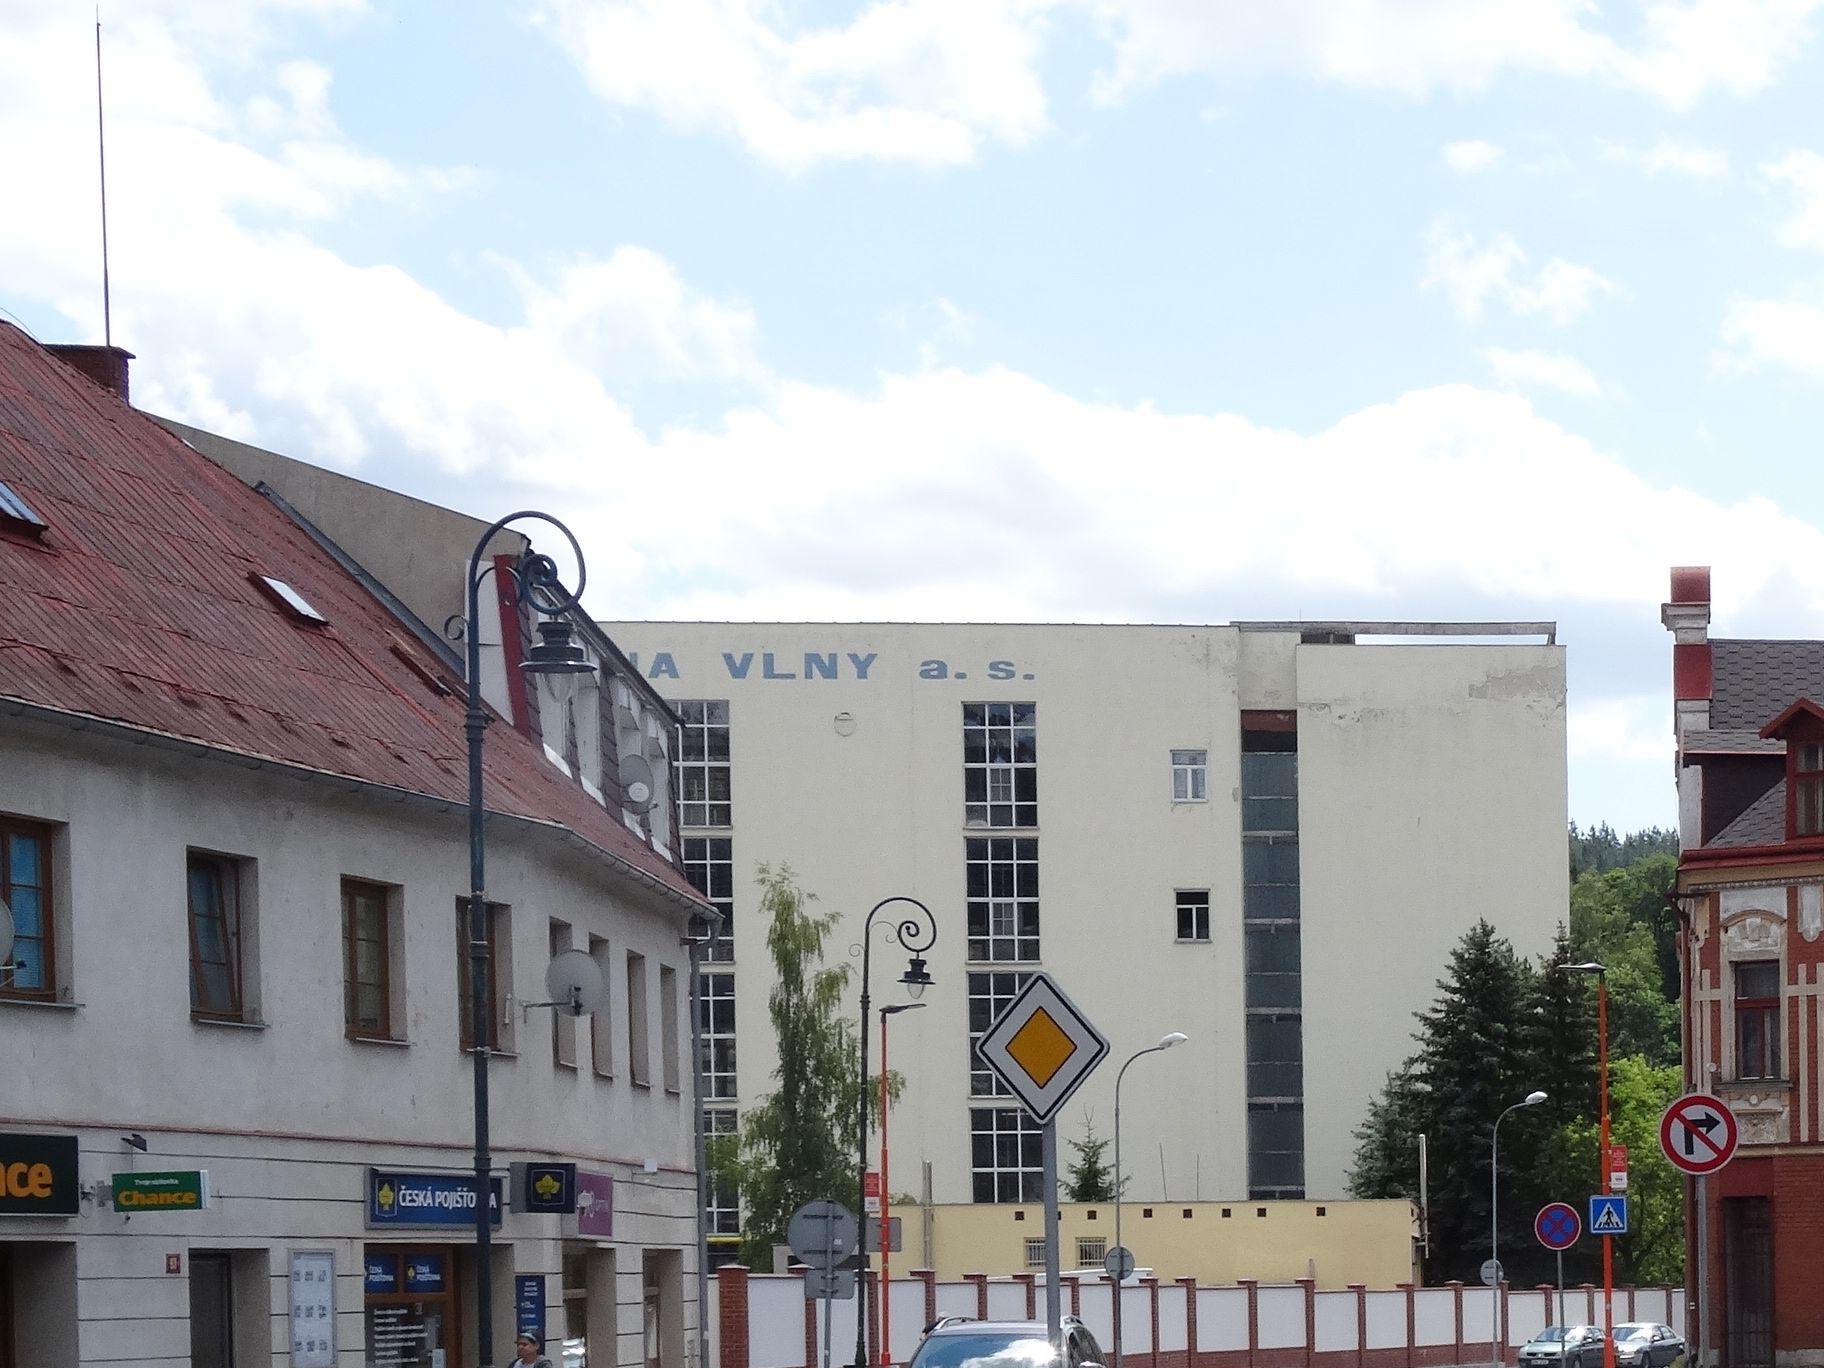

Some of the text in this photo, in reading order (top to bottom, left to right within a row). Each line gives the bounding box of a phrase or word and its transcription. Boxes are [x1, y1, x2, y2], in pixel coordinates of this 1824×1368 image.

[629, 651, 1035, 681] A VLNY a. s.
[0, 1161, 54, 1199] ce
[118, 1190, 197, 1206] Chance
[400, 1185, 497, 1210] ČESKÁ POJIŠŤOA
